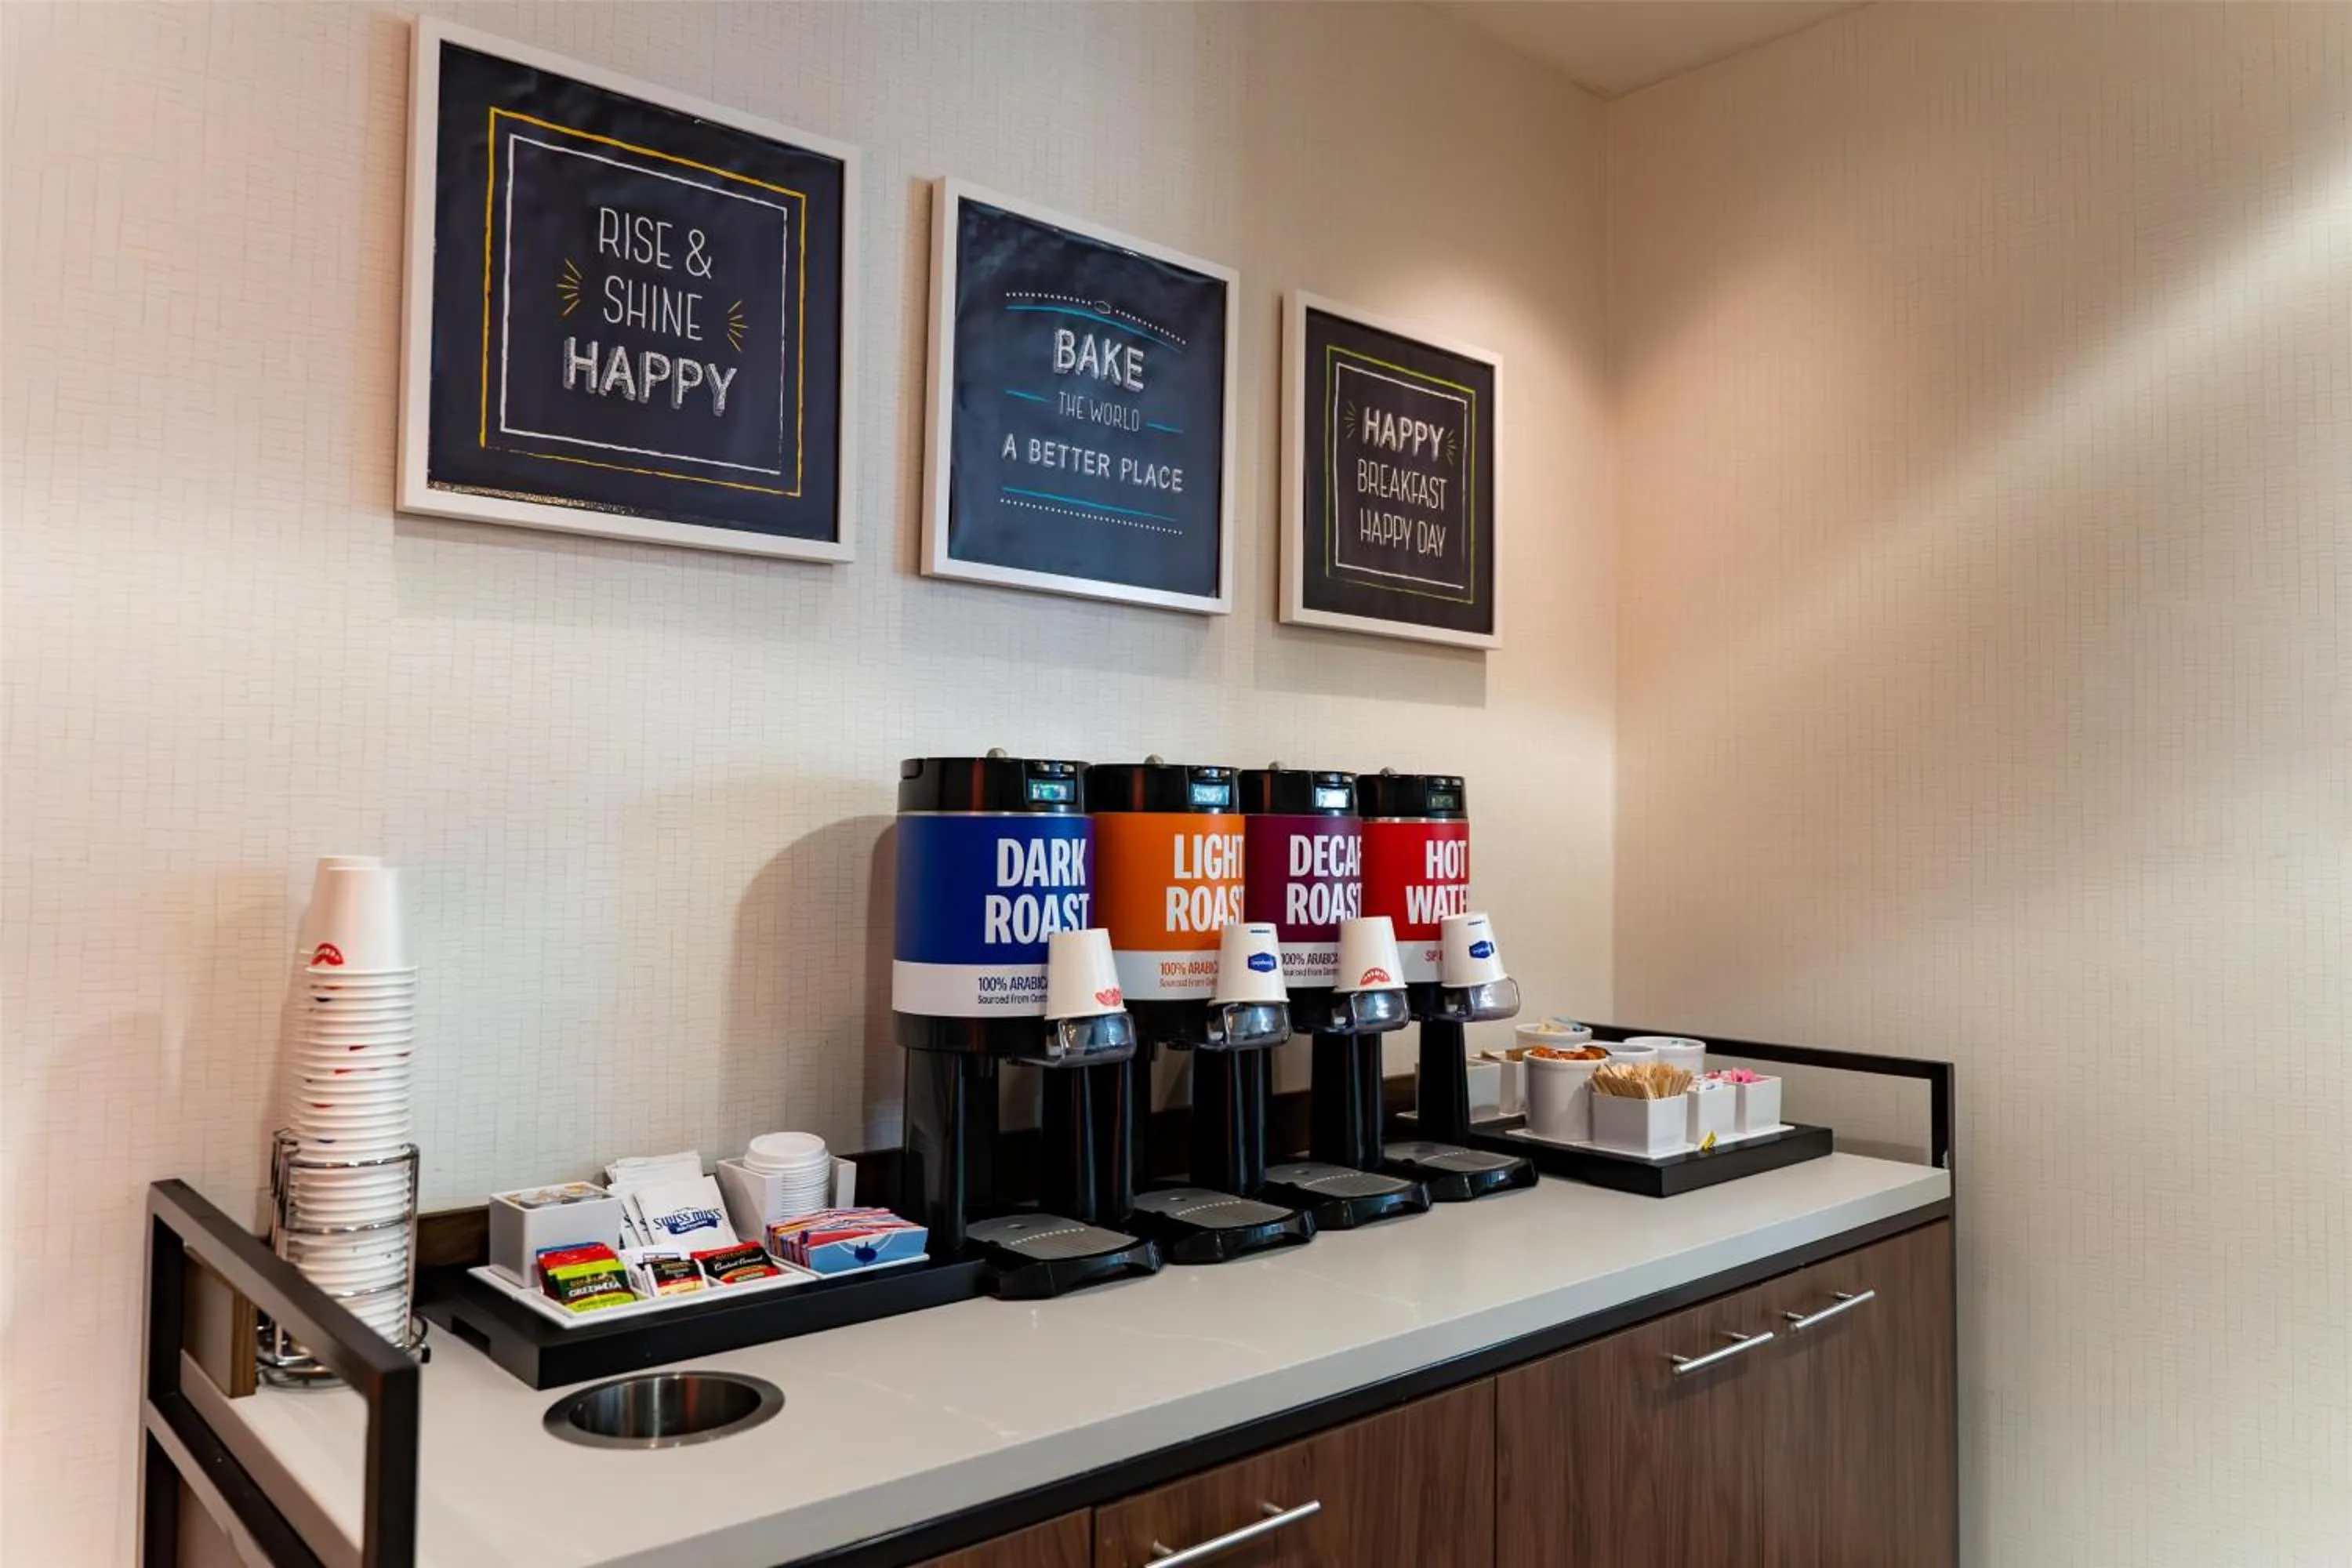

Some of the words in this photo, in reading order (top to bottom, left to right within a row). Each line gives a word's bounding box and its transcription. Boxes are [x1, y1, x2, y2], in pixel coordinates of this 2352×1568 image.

[599, 208, 672, 269] RISE
[686, 229, 712, 278] &
[603, 275, 702, 341] SHINE
[563, 337, 737, 416] HAPPY
[1054, 328, 1144, 391] BAKE
[1058, 392, 1084, 420] THE
[1090, 399, 1140, 433] WORLD
[1363, 406, 1445, 461] HAPPY
[1001, 434, 1018, 460] A
[1029, 437, 1110, 477] BETTER
[1120, 457, 1183, 493] PLACE
[1358, 459, 1449, 511] BREAKFAST
[1359, 507, 1413, 550] HAPPY
[1417, 521, 1446, 558] DAY
[997, 838, 1087, 887] DARK
[1174, 834, 1244, 880] LIGHT
[1425, 840, 1467, 879] HOT
[985, 893, 1091, 944] ROAST
[1406, 885, 1468, 924] WATE
[978, 977, 1007, 991] 100%
[1009, 975, 1047, 990] ARABIC
[1161, 962, 1186, 975] 100%
[1189, 961, 1218, 975] ARABIC
